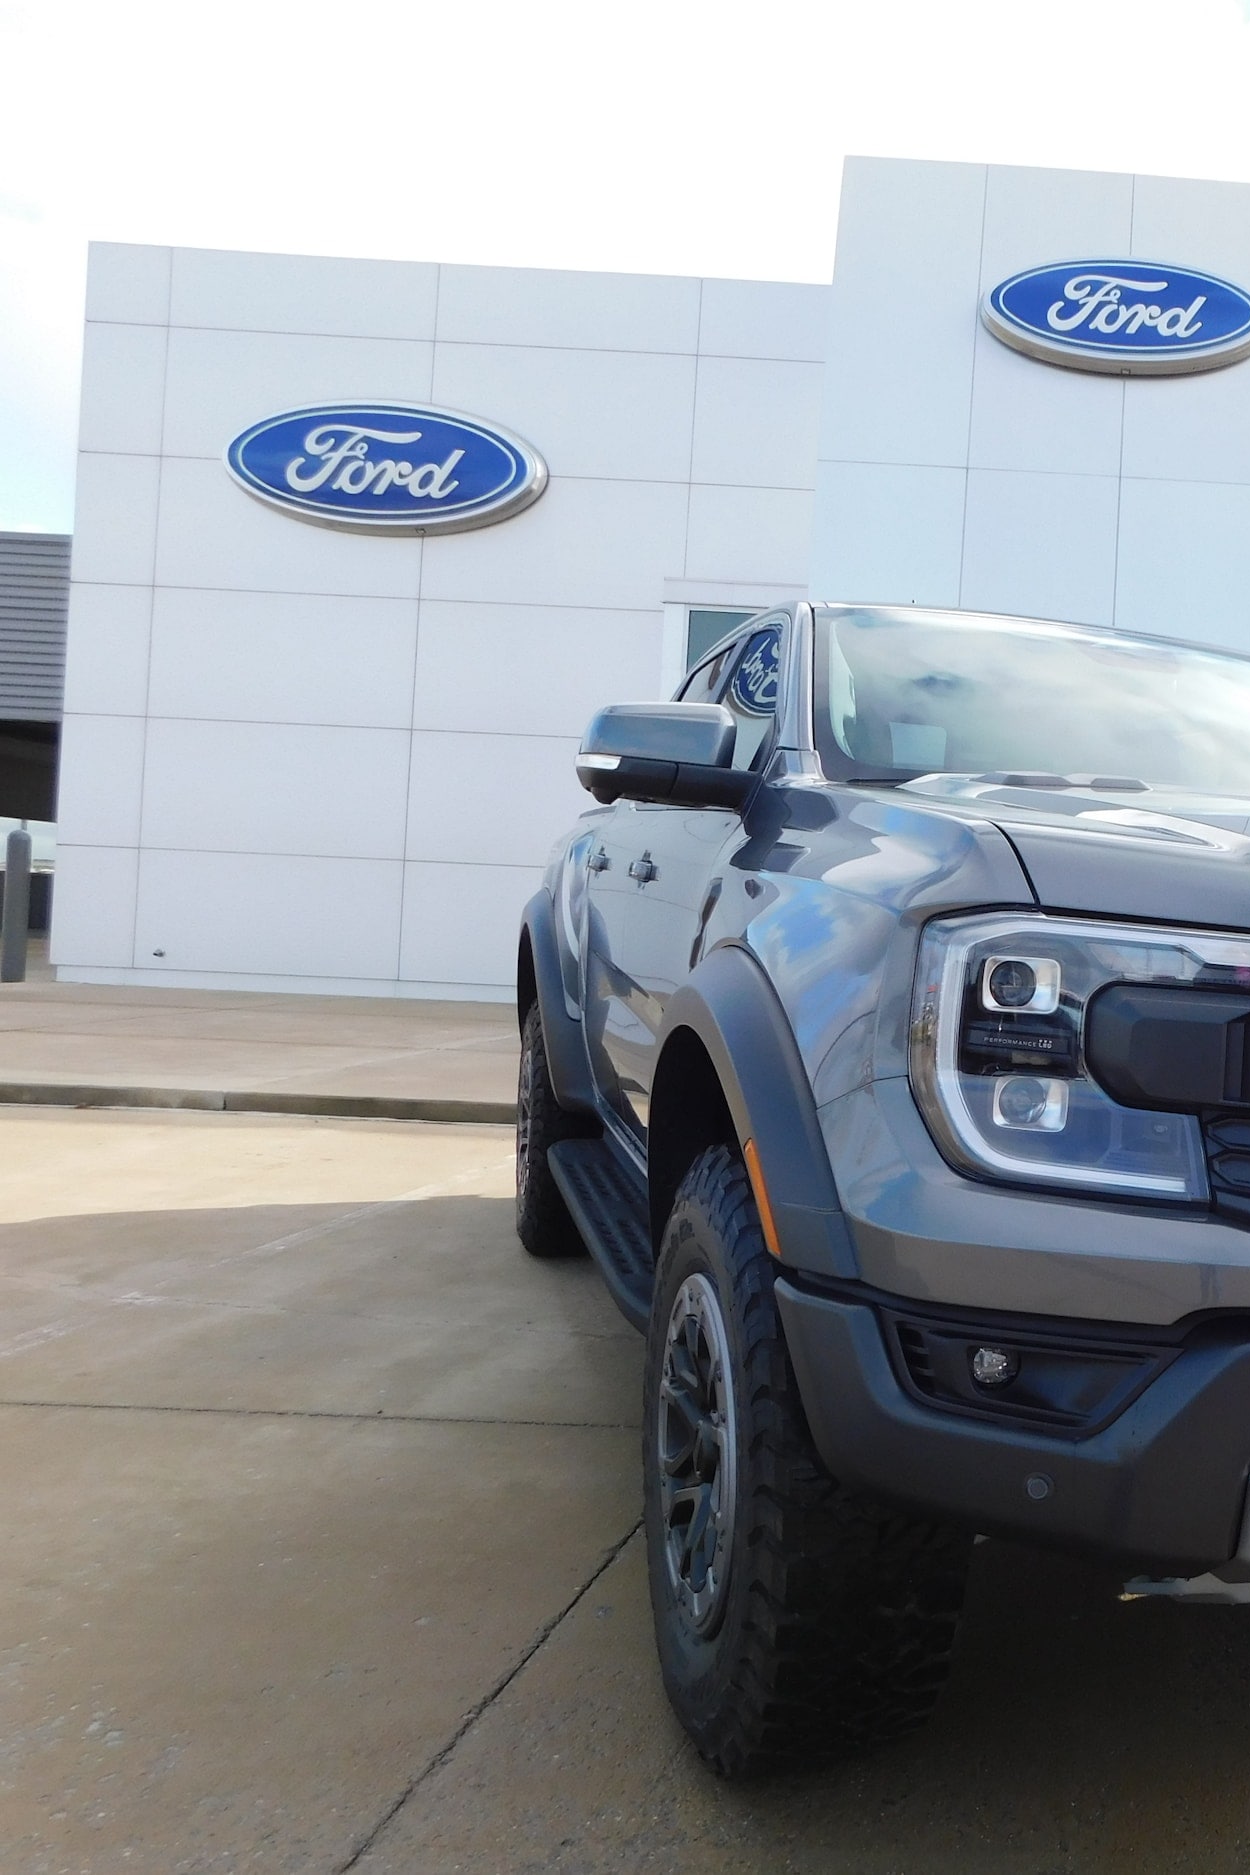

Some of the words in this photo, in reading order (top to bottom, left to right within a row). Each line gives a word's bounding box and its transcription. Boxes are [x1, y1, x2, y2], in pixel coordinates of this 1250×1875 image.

[1047, 274, 1207, 338] Ford
[286, 424, 465, 499] Ford
[983, 1036, 1037, 1048] PERFORMANCE
